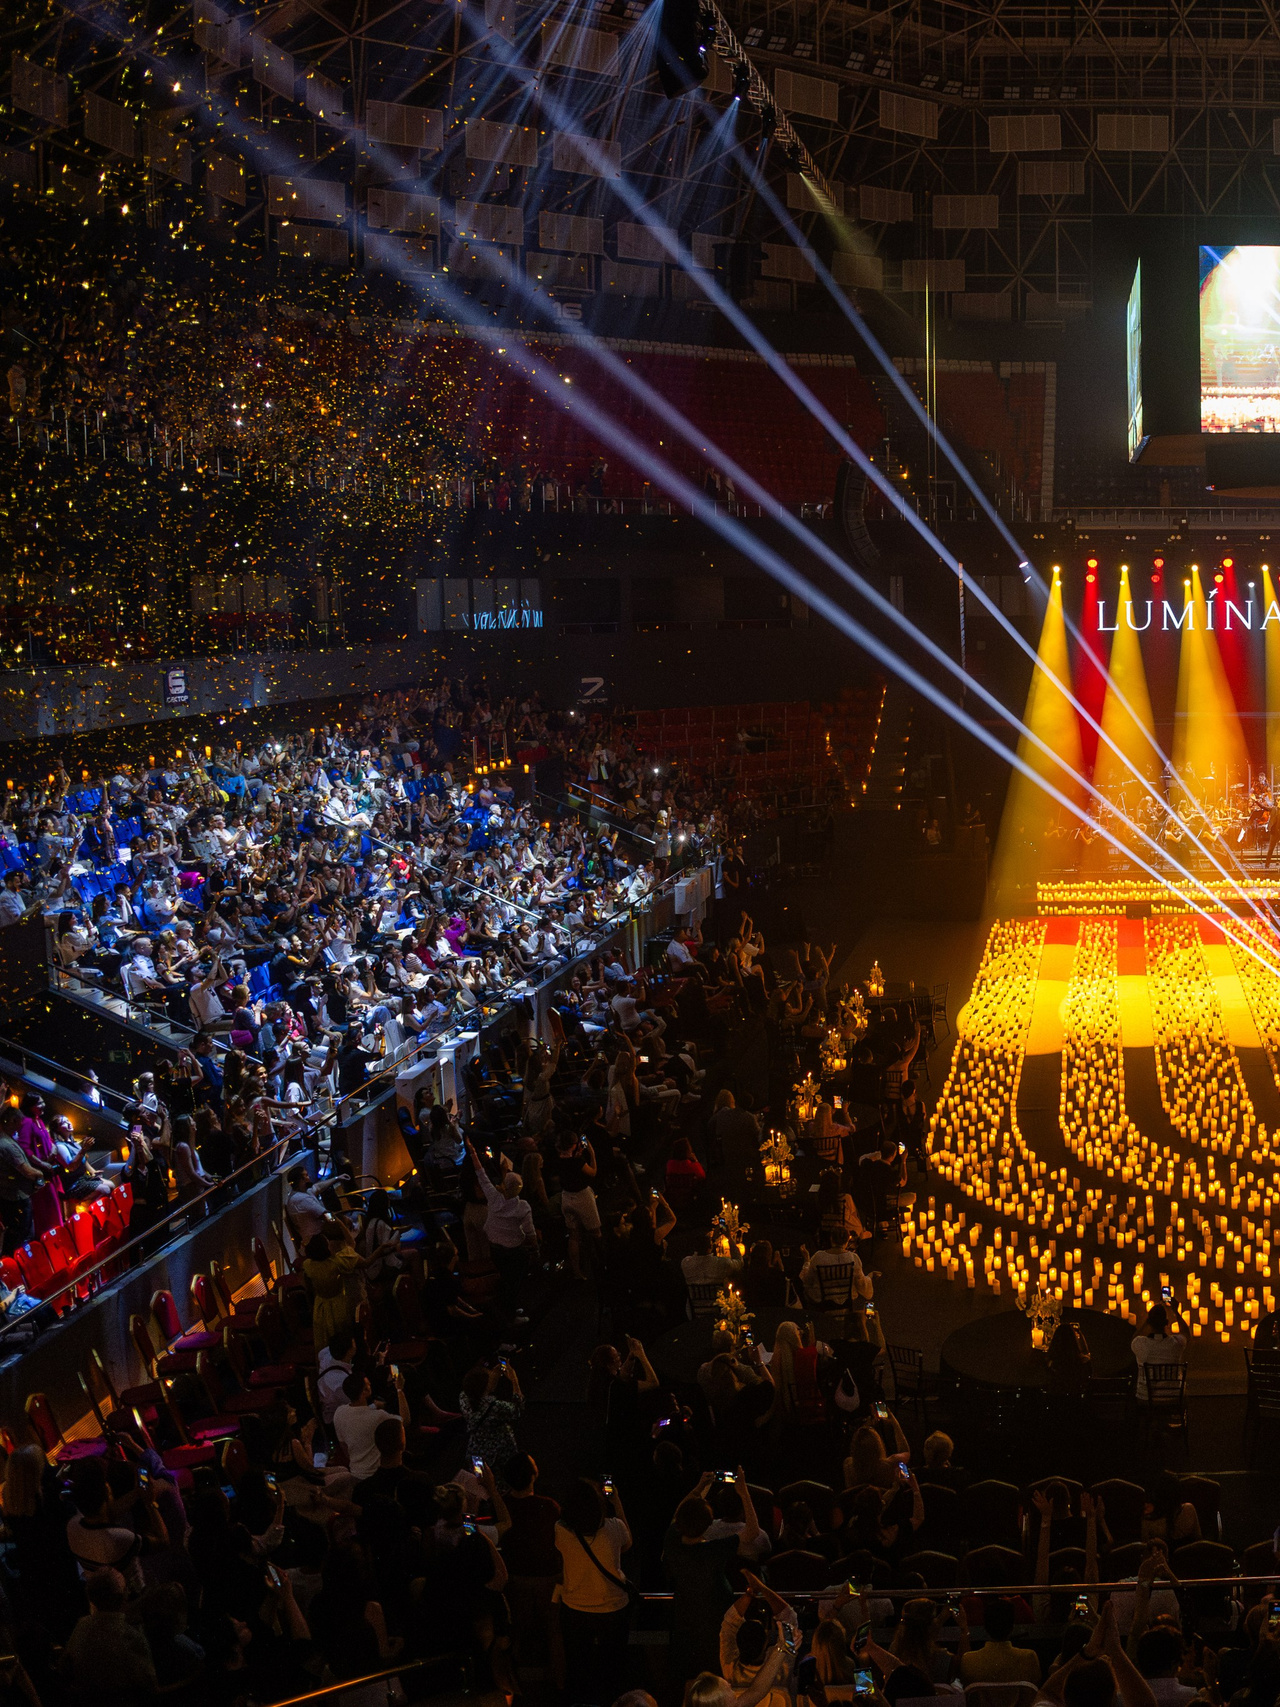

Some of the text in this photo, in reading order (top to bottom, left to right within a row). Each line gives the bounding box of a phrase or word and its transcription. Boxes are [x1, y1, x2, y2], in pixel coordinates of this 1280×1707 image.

[553, 301, 582, 320] 16
[168, 670, 185, 694] 6
[581, 676, 604, 697] 7
